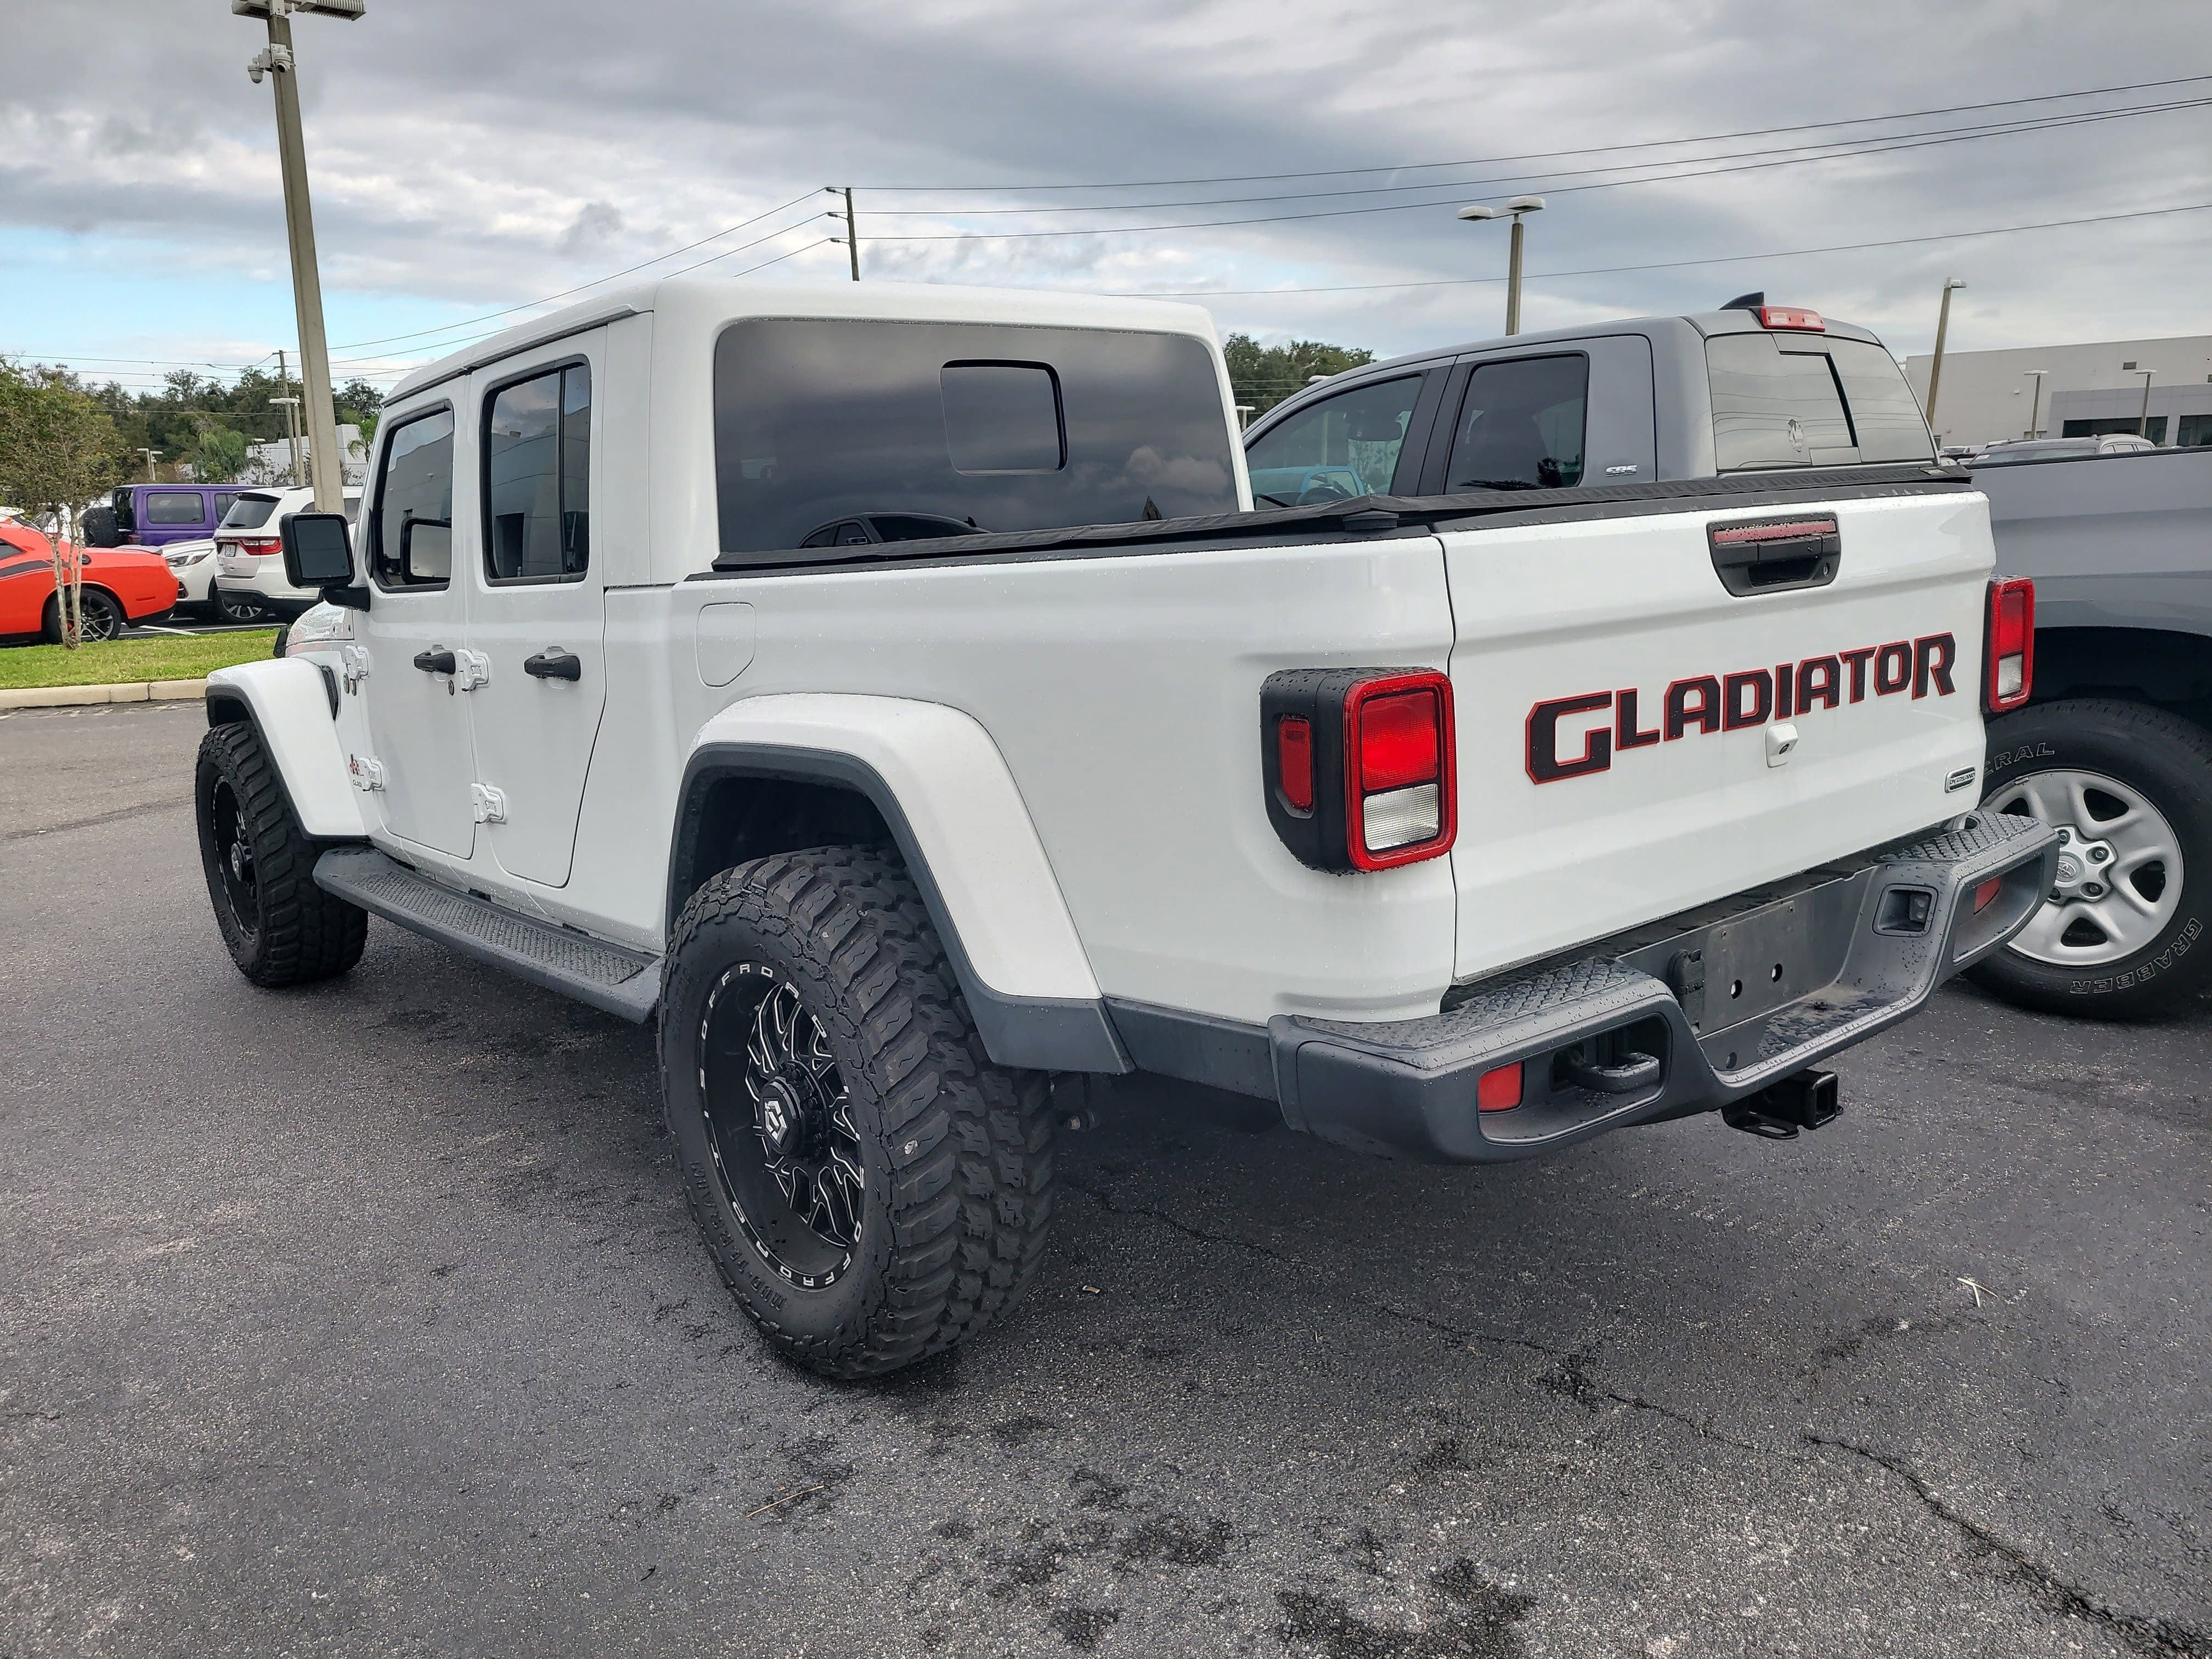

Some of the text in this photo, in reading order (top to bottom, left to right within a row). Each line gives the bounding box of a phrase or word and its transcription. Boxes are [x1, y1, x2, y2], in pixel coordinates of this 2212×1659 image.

[1525, 631, 1956, 785] GLADIATOR
[1949, 772, 1976, 785] OVERLAND
[1983, 742, 2055, 778] ERAL
[2069, 918, 2203, 994] GRABBER
